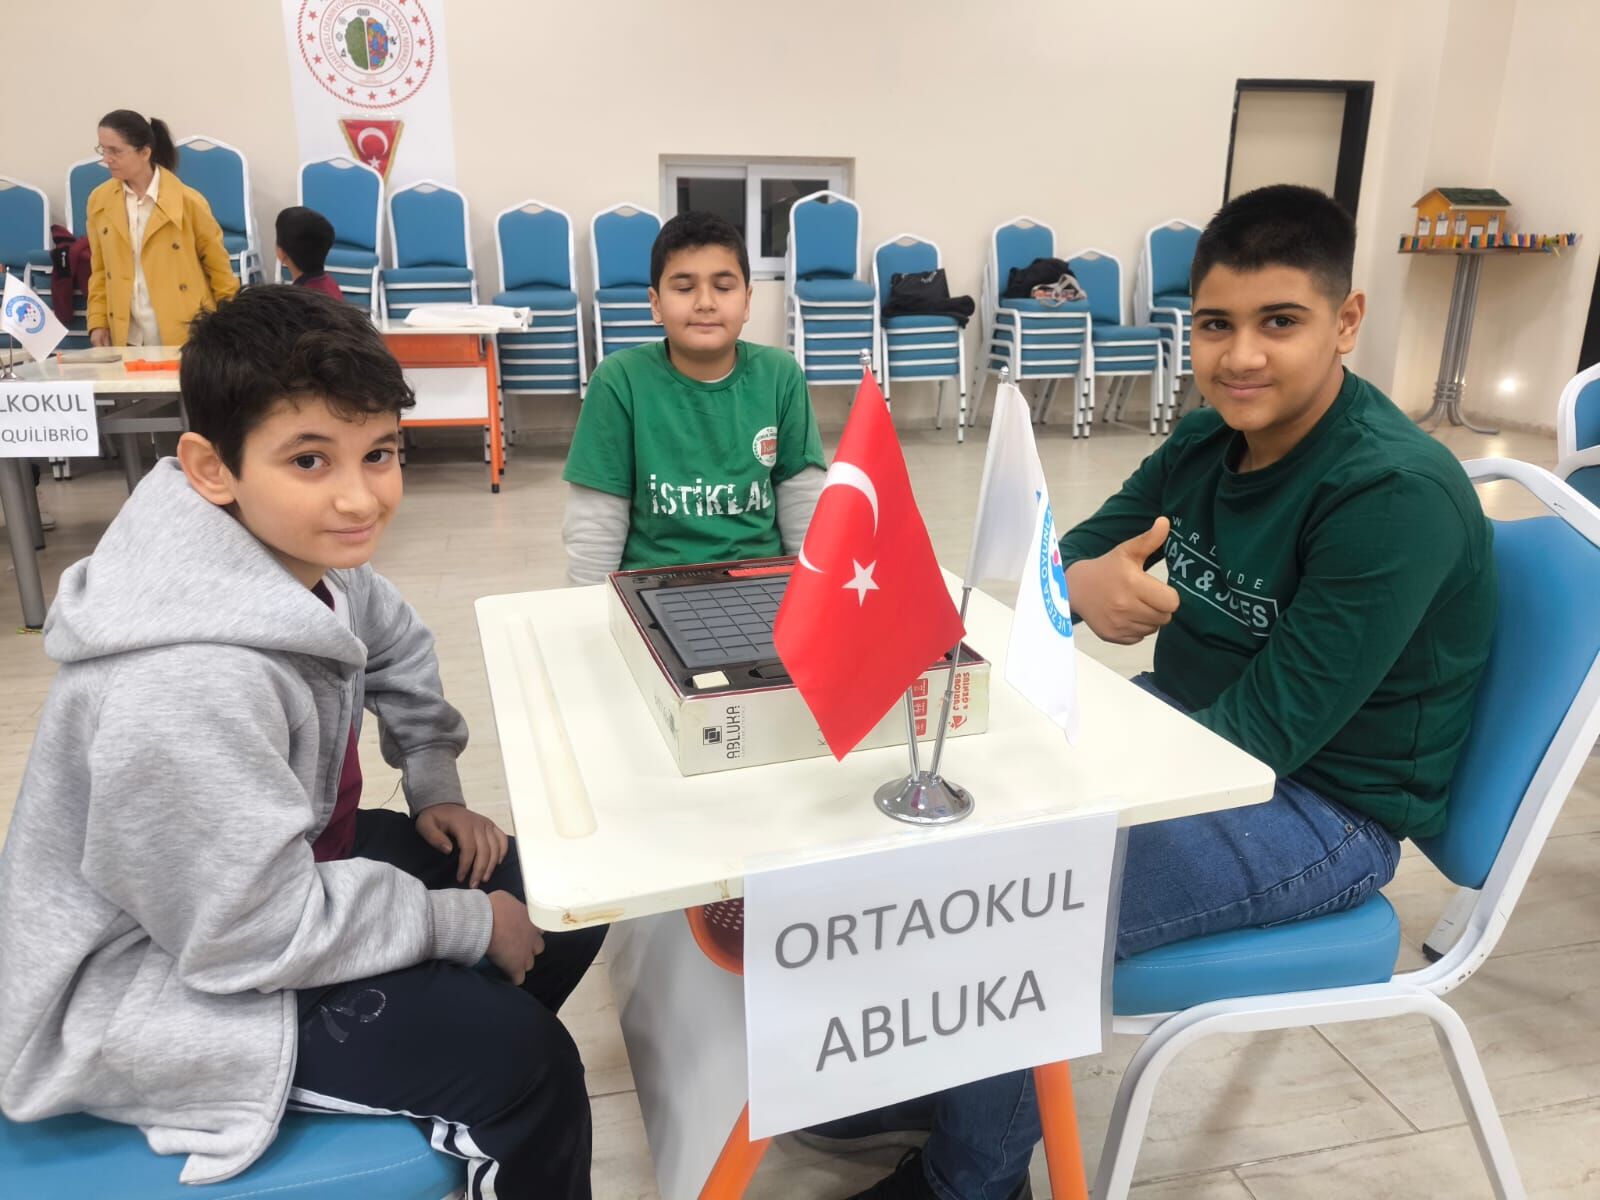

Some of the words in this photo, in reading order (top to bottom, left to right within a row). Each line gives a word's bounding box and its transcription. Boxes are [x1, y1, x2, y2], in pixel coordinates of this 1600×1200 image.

[0, 394, 87, 412] KOKUL
[1195, 570, 1216, 592] &
[952, 672, 962, 711] CURIOUS
[962, 672, 970, 703] GENIUS
[726, 705, 741, 759] ABLUKA
[775, 869, 1085, 969] ORTAOKUL
[816, 970, 1046, 1072] ABLUKA
